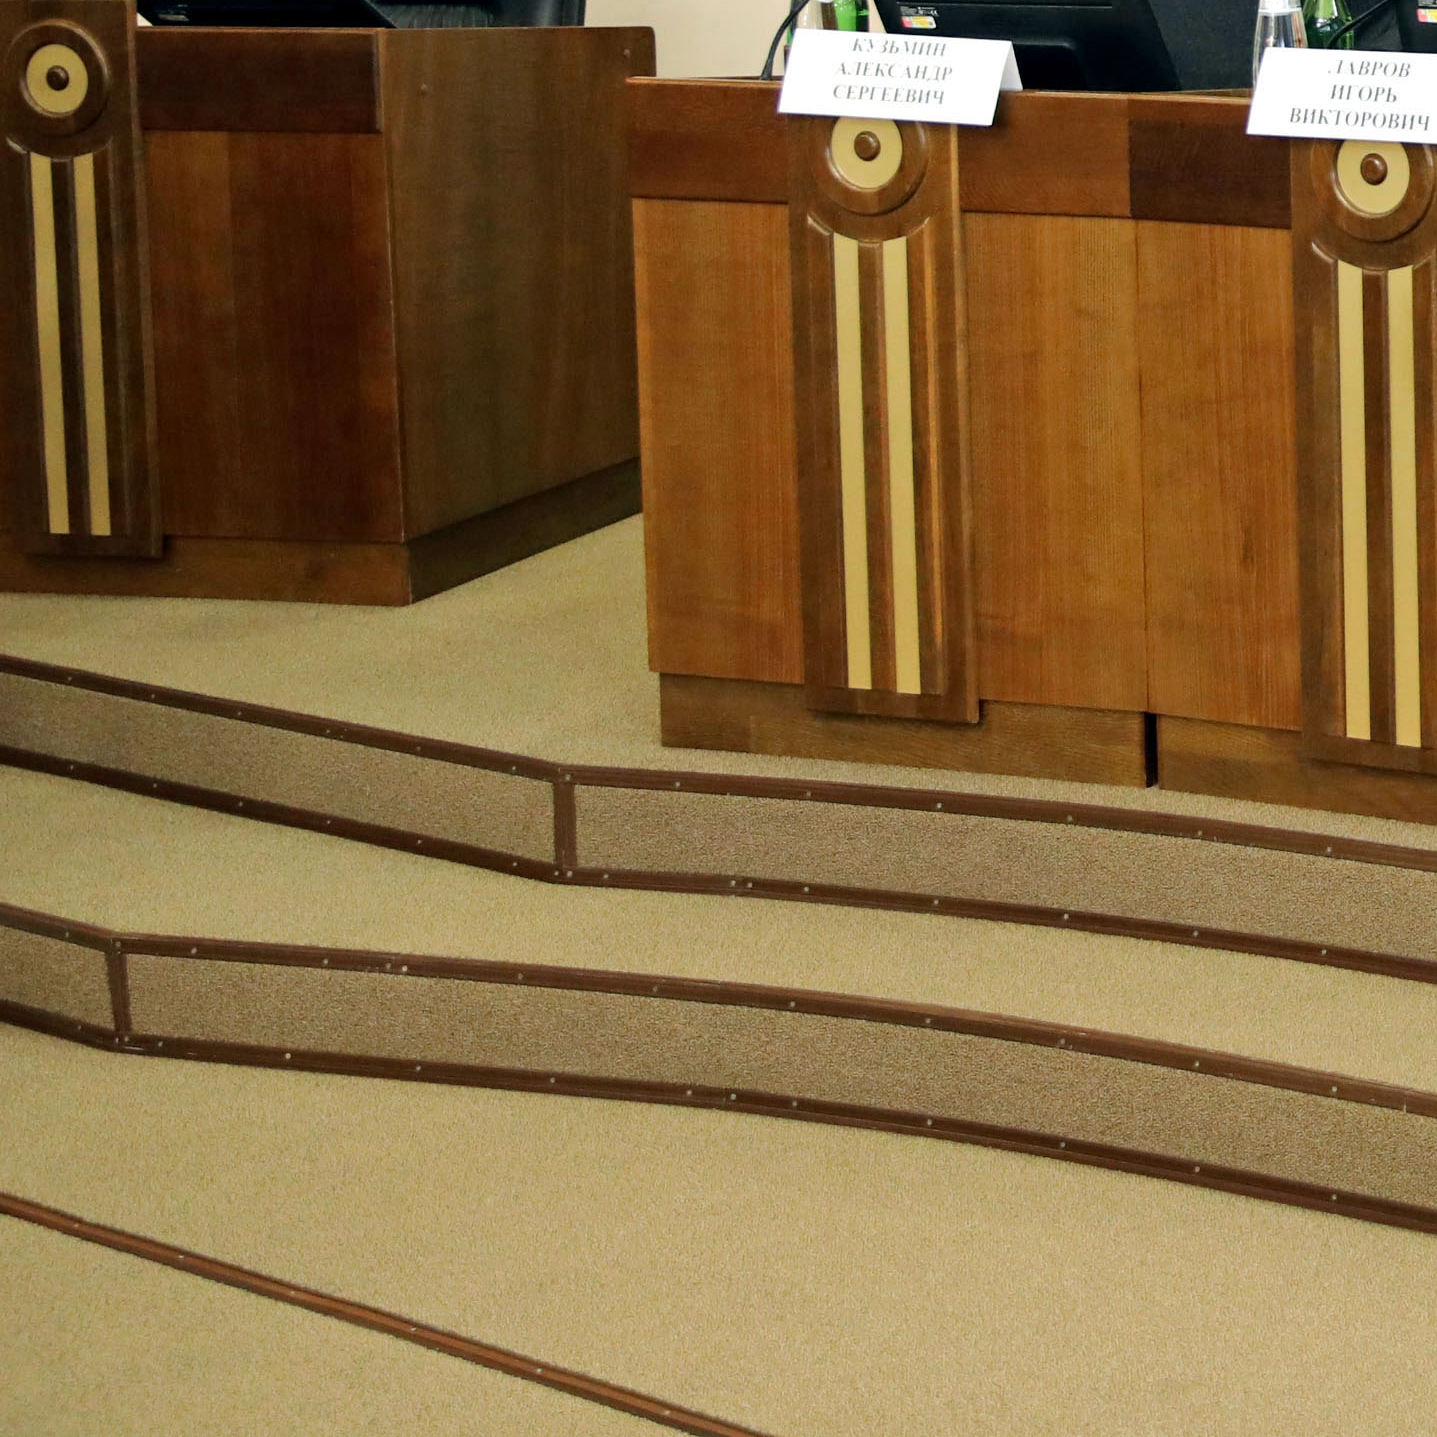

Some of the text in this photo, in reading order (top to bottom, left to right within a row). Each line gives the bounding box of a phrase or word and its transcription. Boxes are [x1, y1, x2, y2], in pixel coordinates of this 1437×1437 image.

[851, 38, 947, 57] КУЗЬМИН
[834, 61, 953, 81] АЛЕКСАНДР
[1328, 59, 1411, 78] ЛАВРОВ
[832, 84, 945, 105] СЕРГЕЕВИЧ
[1329, 83, 1398, 103] ИГОРЬ
[1289, 106, 1430, 132] ВИКТОРОВИЧ
